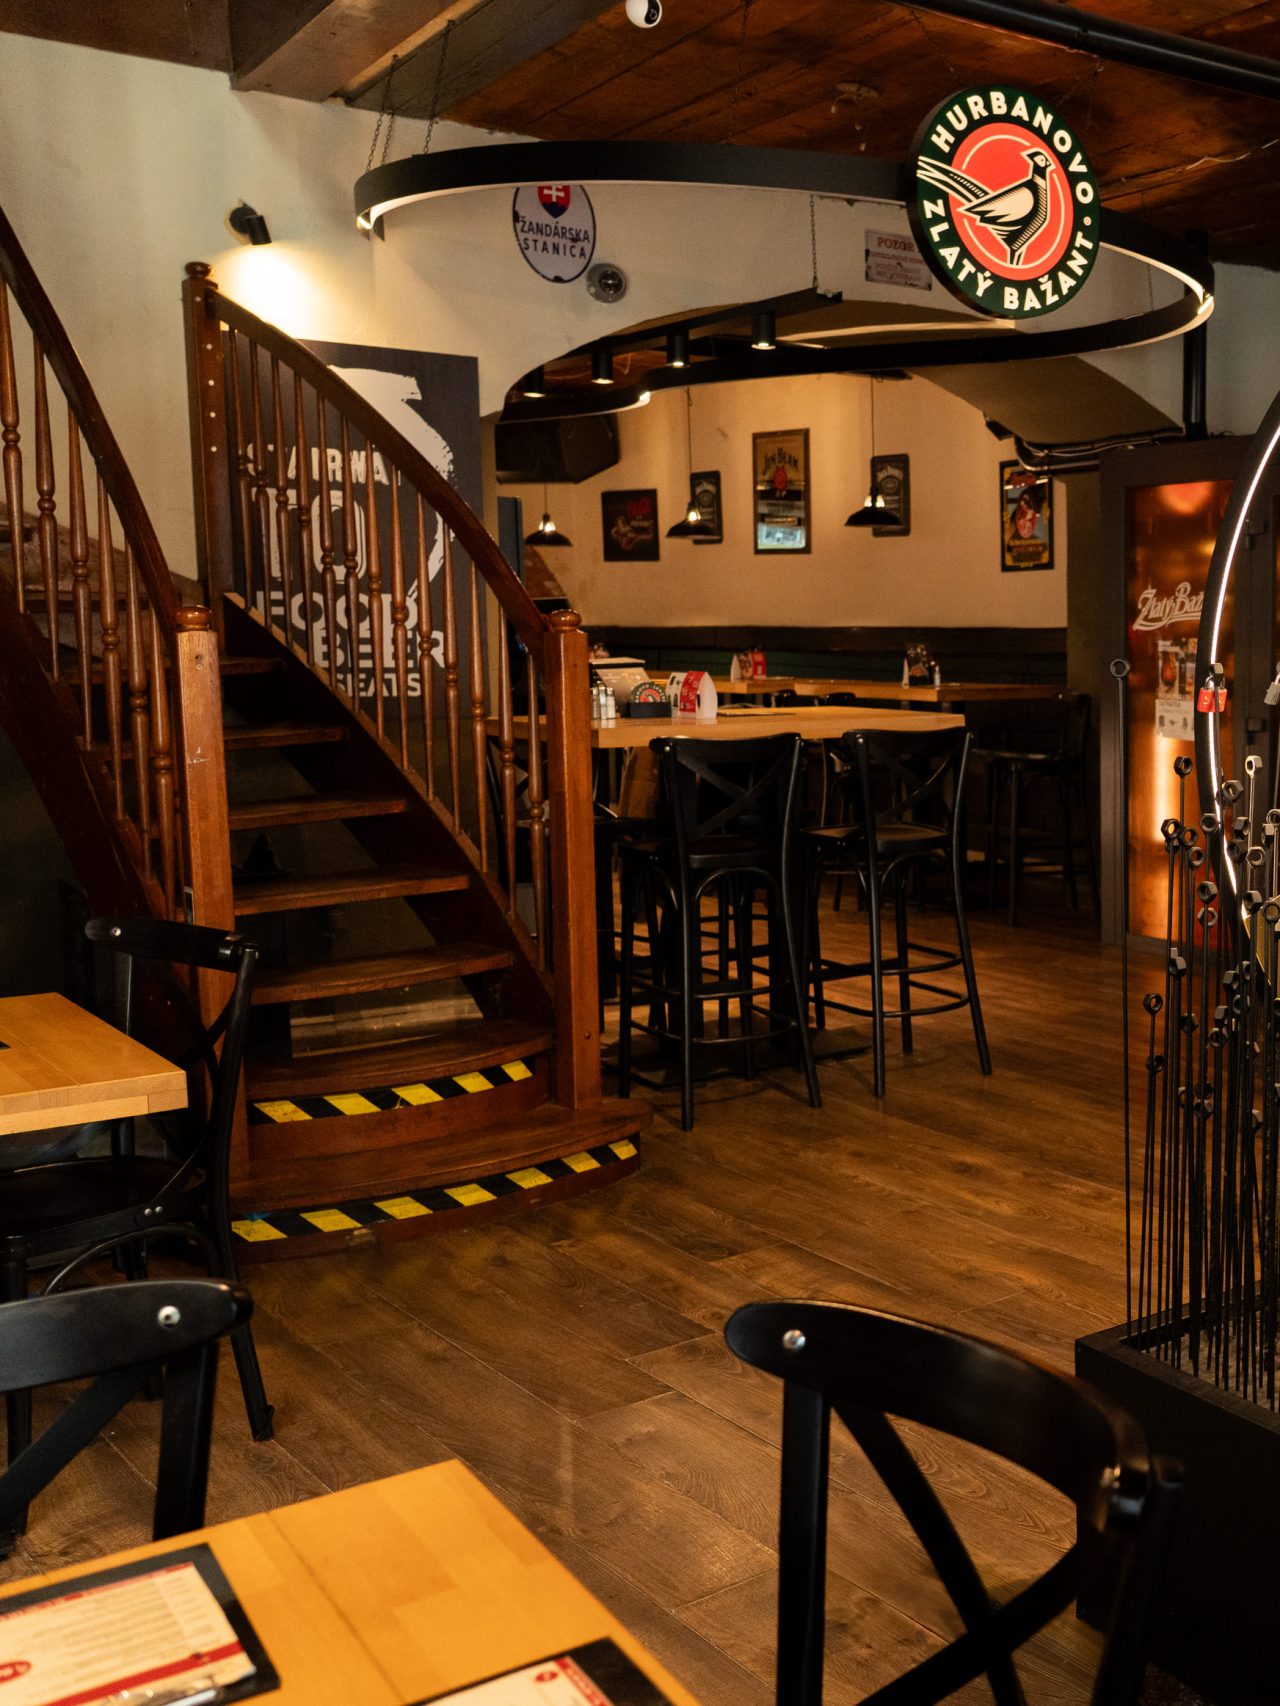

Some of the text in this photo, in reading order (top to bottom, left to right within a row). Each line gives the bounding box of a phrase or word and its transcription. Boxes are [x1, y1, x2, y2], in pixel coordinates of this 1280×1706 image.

[930, 90, 1094, 205] HURBANOVO
[520, 216, 591, 244] ŽANDÁRSKA
[522, 237, 587, 260] STANICA
[922, 199, 1094, 312] ZLATÝ BAŽANT
[251, 486, 368, 585] TO
[255, 589, 420, 633] FOOD
[312, 630, 447, 670] BEER
